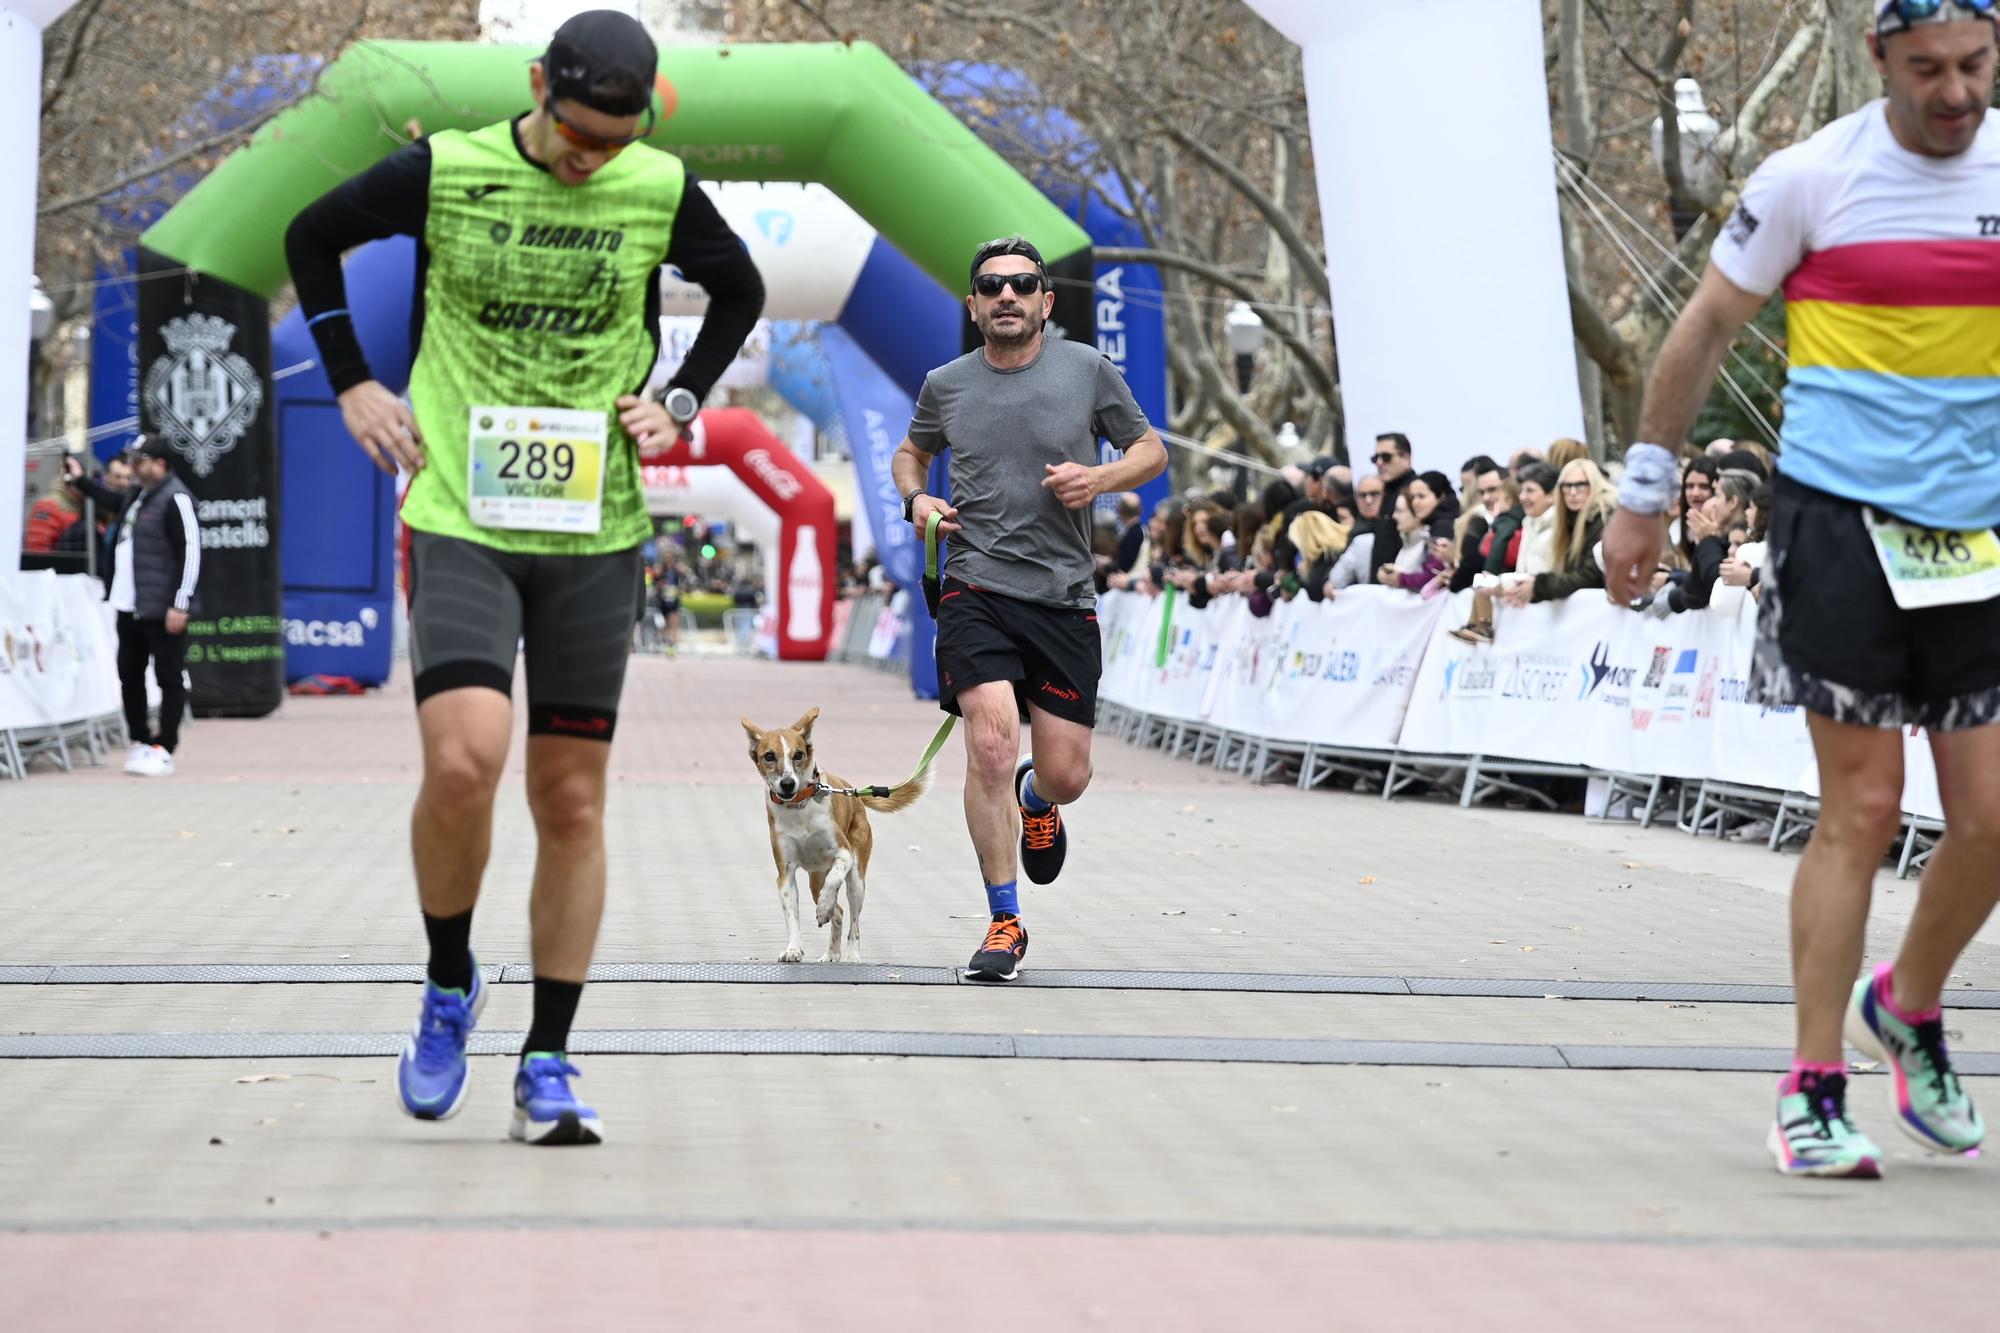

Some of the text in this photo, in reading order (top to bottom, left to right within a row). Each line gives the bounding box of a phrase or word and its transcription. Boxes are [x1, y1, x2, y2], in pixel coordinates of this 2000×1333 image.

[497, 440, 575, 482] 289
[504, 482, 565, 497] VICTOR
[197, 496, 267, 521] ament
[1904, 530, 1971, 565] 426
